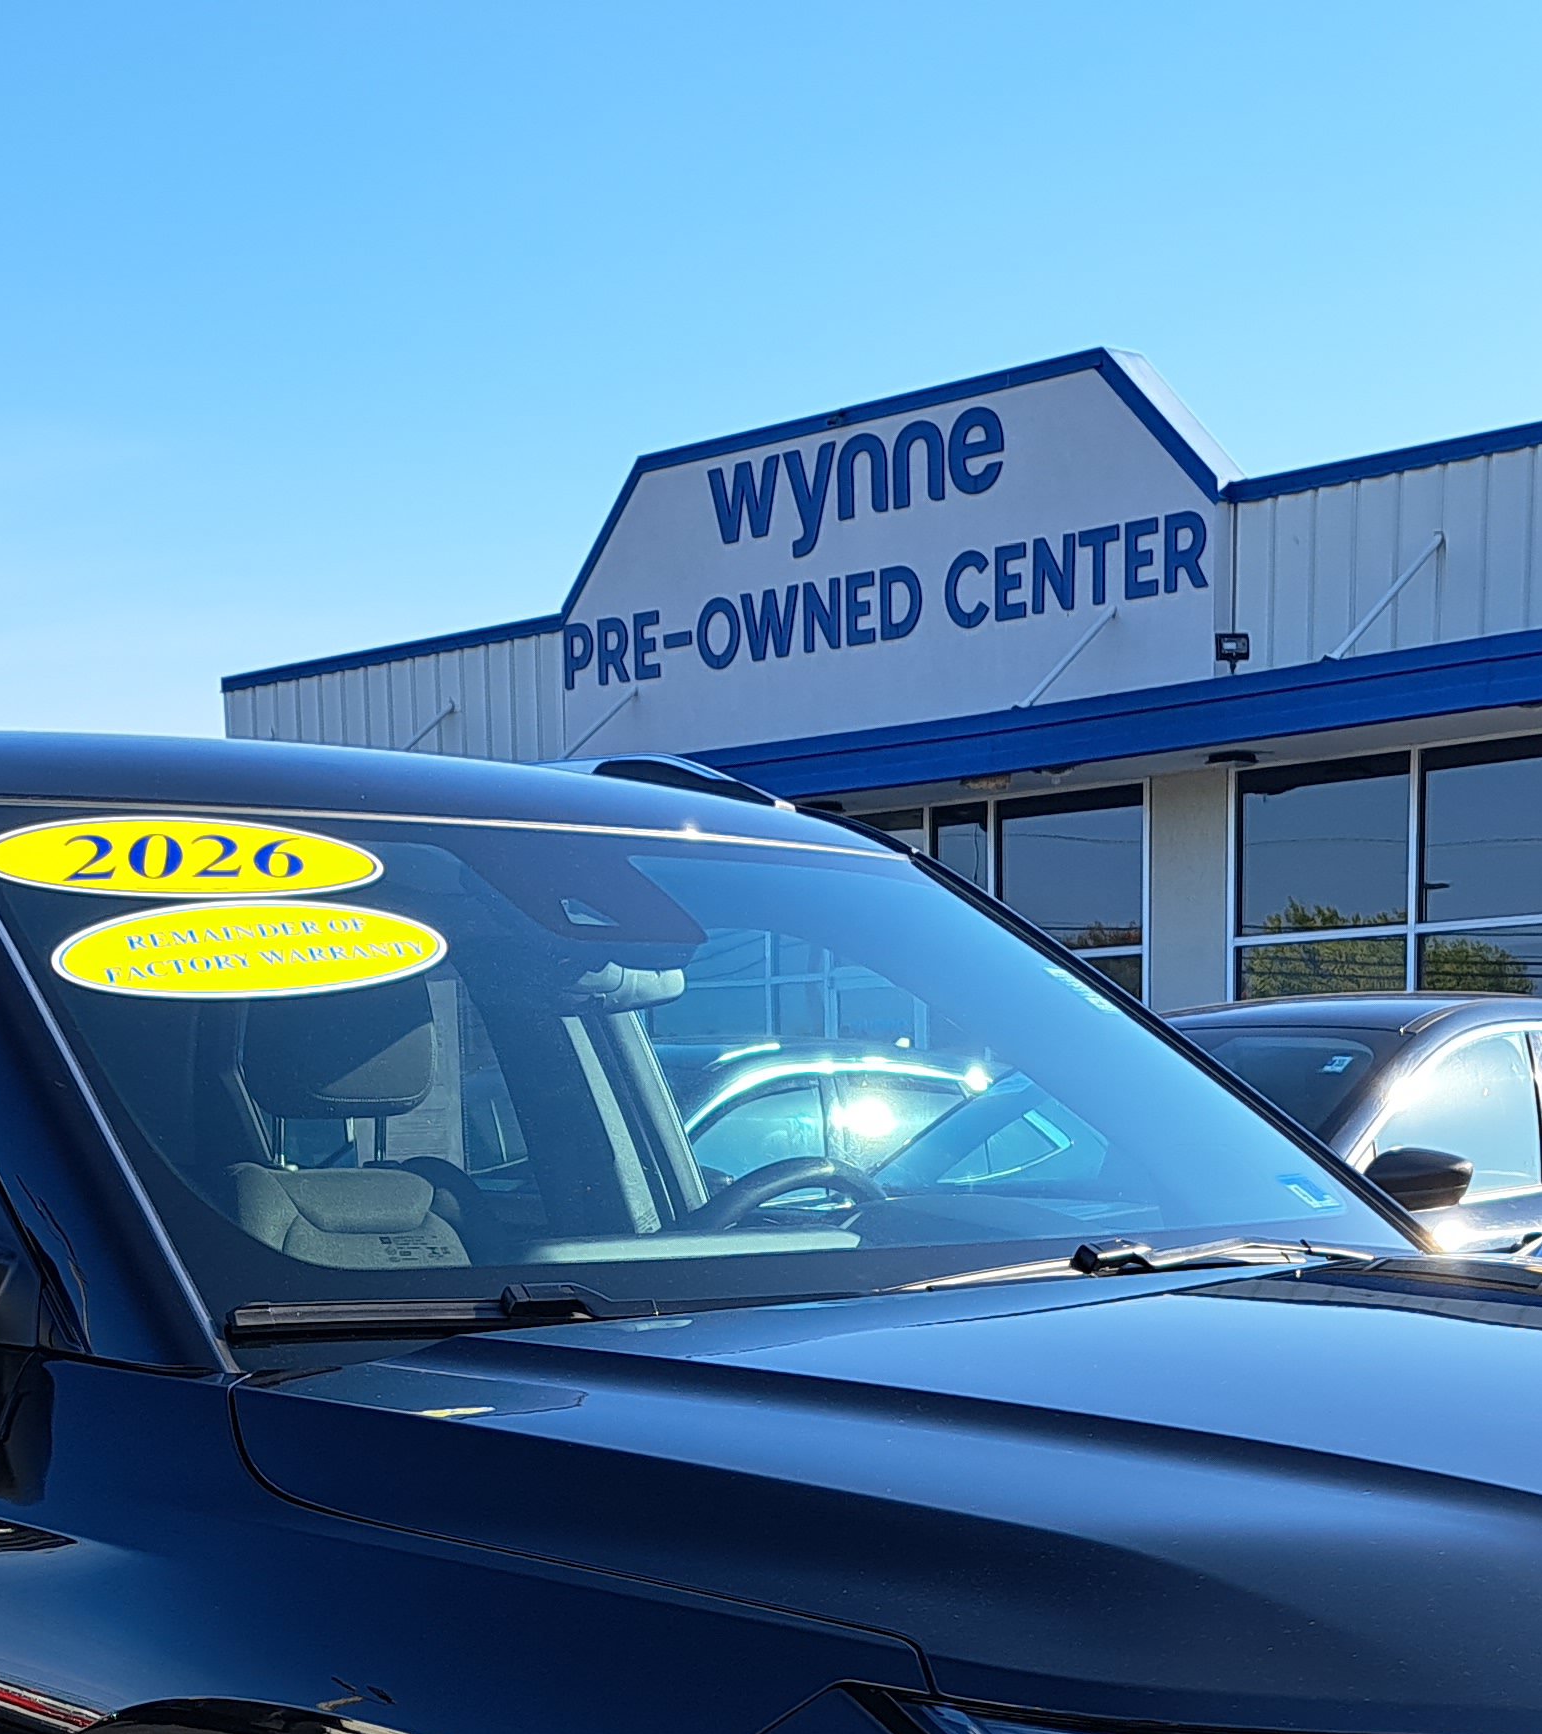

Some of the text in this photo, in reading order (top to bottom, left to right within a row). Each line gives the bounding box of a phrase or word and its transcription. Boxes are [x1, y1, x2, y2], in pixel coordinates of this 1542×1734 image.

[707, 406, 1005, 558] wynne
[563, 509, 1209, 691] PRE-OWNED CENTER
[62, 832, 306, 882] 2026
[125, 916, 368, 952] REMAINDER OF
[104, 940, 425, 985] FACTORY WARRANTY
